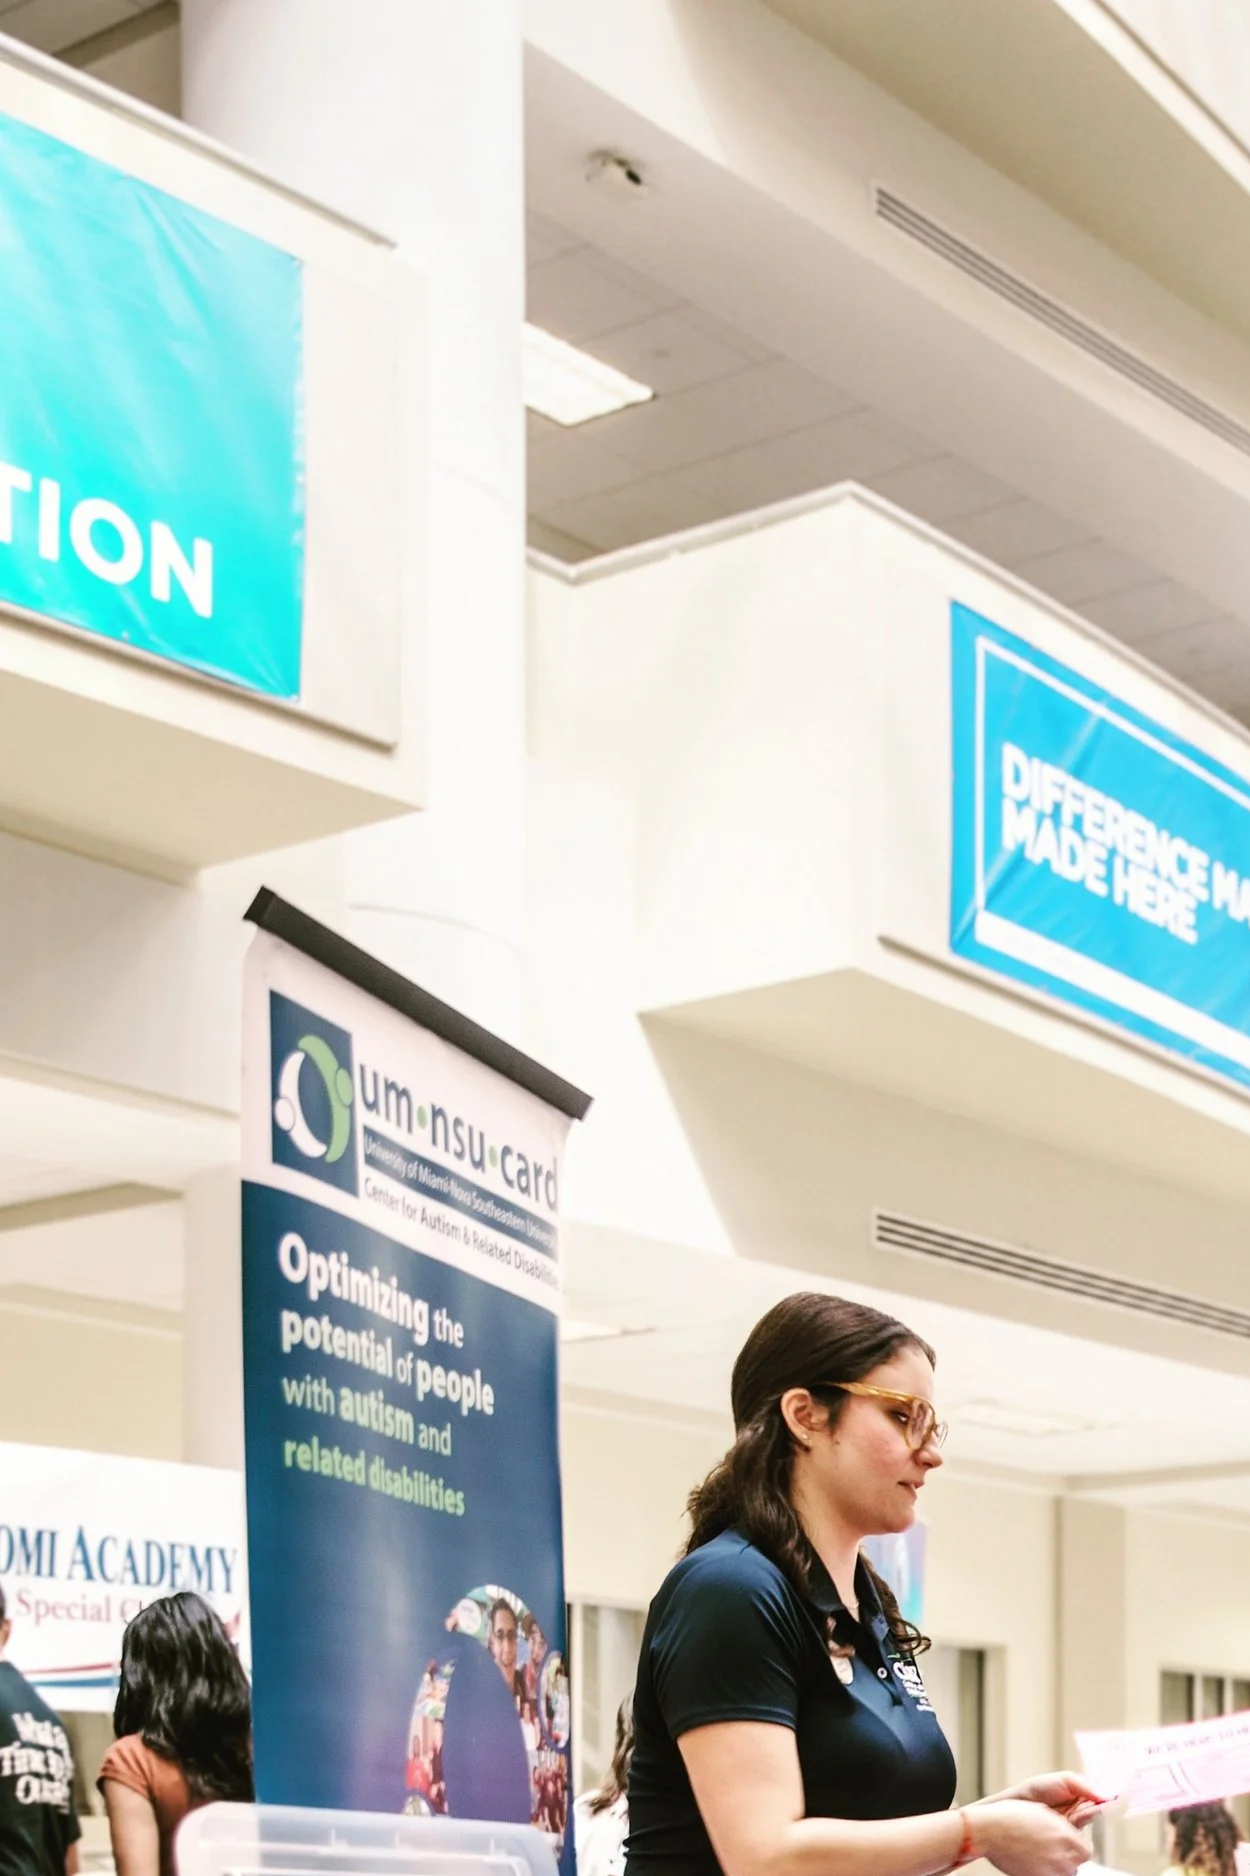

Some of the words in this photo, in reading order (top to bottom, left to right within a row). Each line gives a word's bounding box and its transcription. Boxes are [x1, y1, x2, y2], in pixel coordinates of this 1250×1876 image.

[1001, 740, 1210, 903] DIFFERENCE
[1001, 794, 1109, 899] MADE
[1112, 853, 1199, 946] HERE
[364, 1134, 406, 1177] University
[407, 1162, 418, 1180] of
[364, 1176, 399, 1206] Center
[401, 1196, 418, 1220] for
[420, 1207, 462, 1243] Autism
[463, 1225, 471, 1246] &
[473, 1230, 512, 1266] Related
[279, 1231, 429, 1346] Optimizing
[433, 1308, 464, 1348] the
[280, 1308, 394, 1379] potential
[396, 1352, 413, 1386] of
[416, 1357, 495, 1416] people
[282, 1374, 335, 1416] with
[339, 1386, 414, 1444] autism
[418, 1422, 452, 1457] and
[284, 1436, 366, 1486] related
[369, 1455, 466, 1517] disabilities
[66, 1524, 239, 1594] ACADEMY
[15, 1587, 113, 1628] Special
